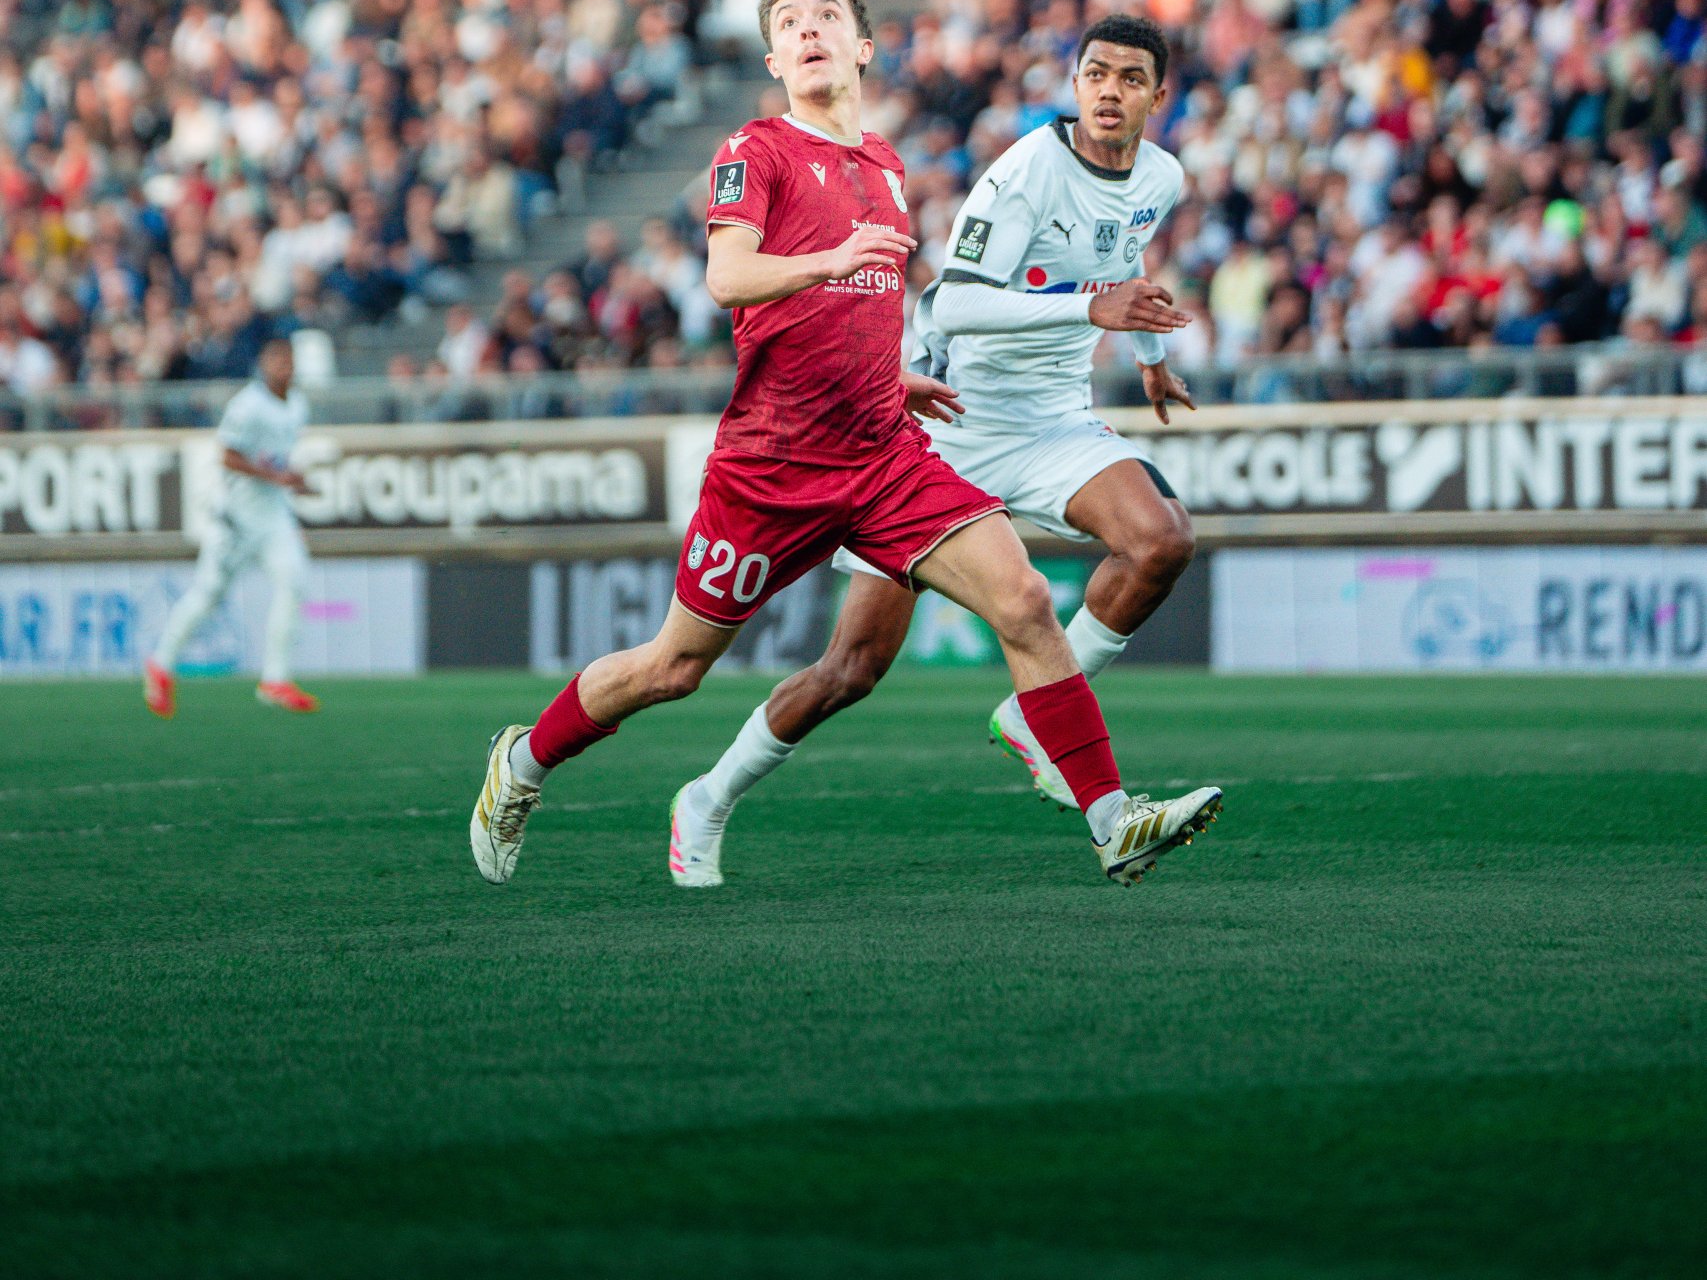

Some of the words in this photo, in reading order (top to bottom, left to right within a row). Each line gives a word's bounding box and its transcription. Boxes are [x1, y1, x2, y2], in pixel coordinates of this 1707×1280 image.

[828, 269, 899, 294] ergia
[845, 286, 854, 294] DE
[854, 287, 875, 296] FRANCE
[286, 436, 647, 540] Groupama
[1138, 430, 1372, 509] RICOLE
[1466, 417, 1707, 509] INTER
[698, 539, 770, 603] 20
[0, 592, 137, 660] R.FR
